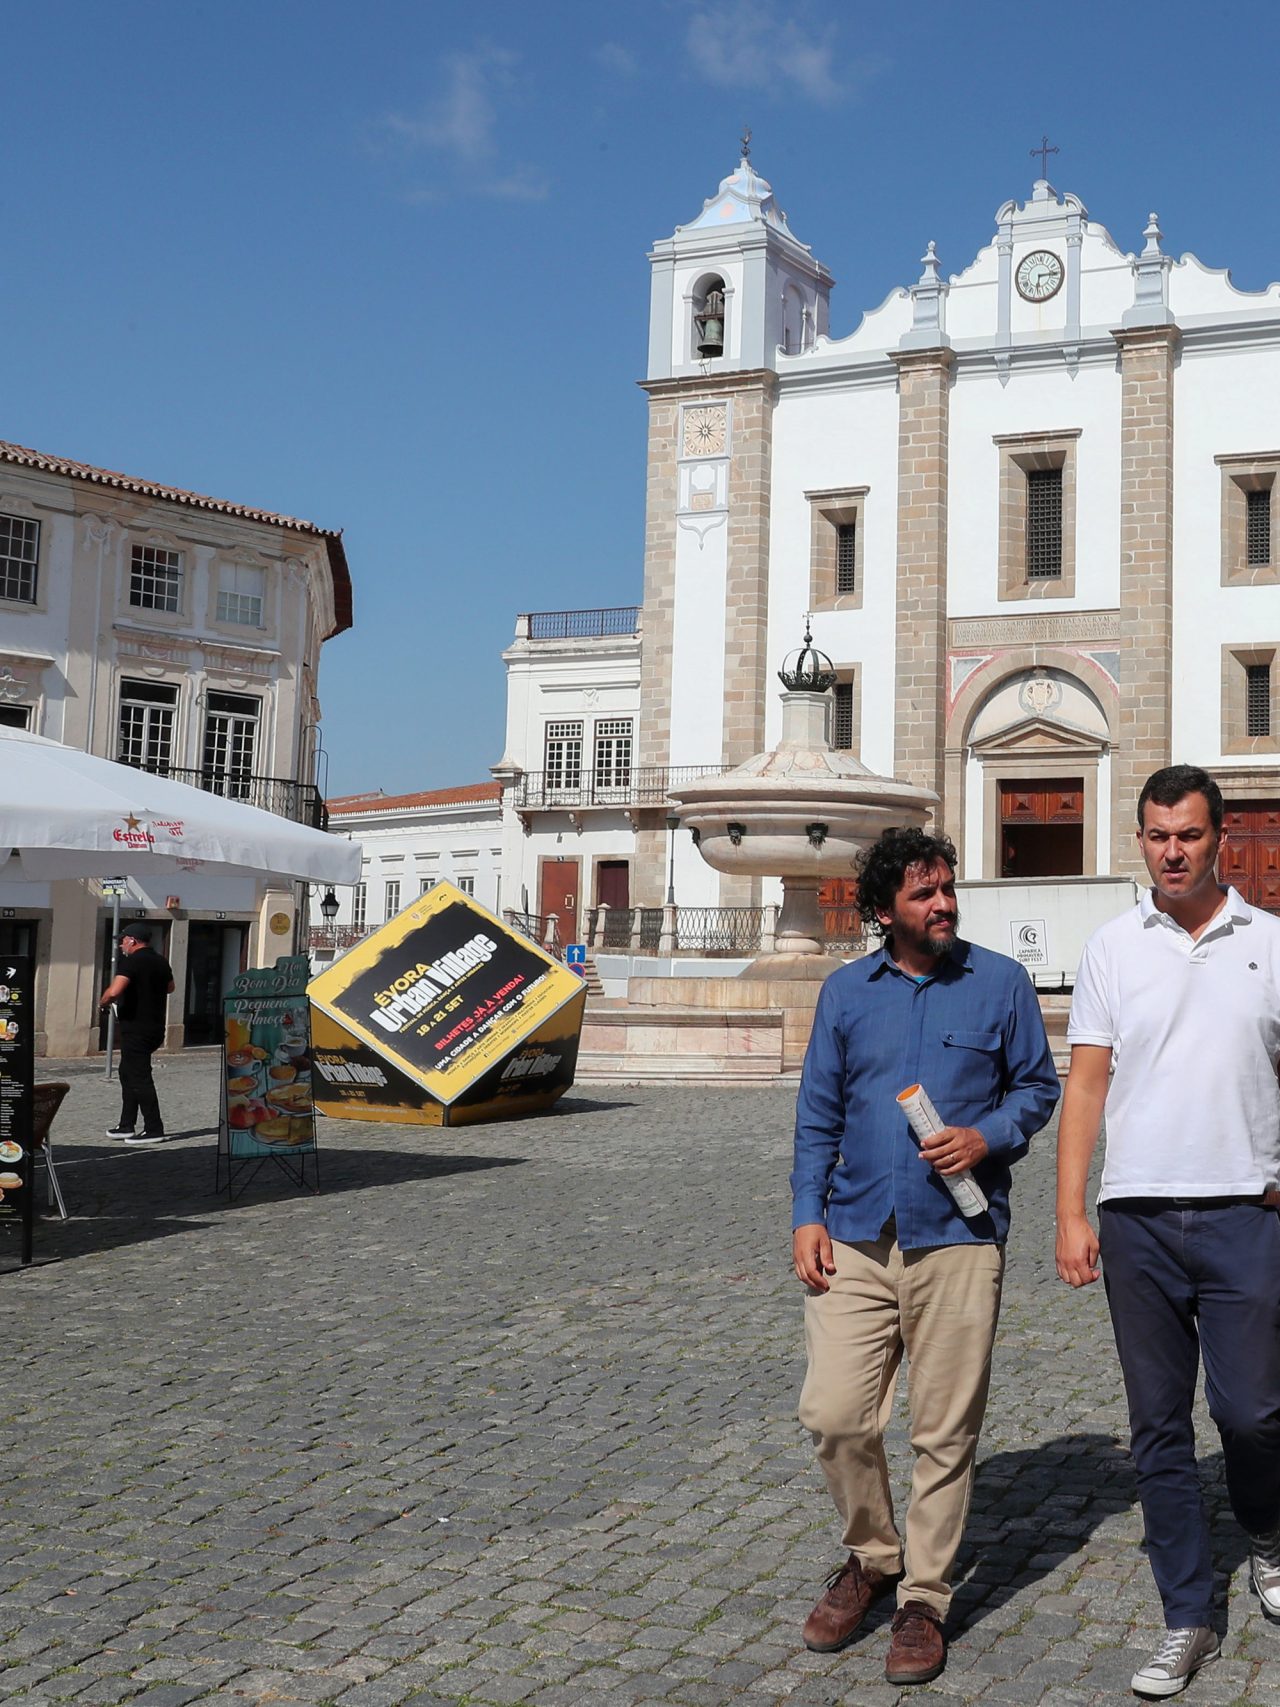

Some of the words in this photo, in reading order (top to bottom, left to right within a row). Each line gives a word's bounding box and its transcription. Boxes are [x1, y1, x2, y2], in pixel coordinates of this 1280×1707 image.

[113, 827, 155, 843] Estrella
[236, 977, 267, 995] Bom
[271, 975, 300, 993] Dia
[369, 977, 443, 1034] Urban
[425, 933, 498, 988] Village
[373, 963, 432, 1007] ÉVORA
[234, 998, 289, 1014] Pequeno
[444, 994, 465, 1013] SET
[432, 1008, 447, 1022] 21
[433, 1015, 475, 1051] BILHETES
[470, 1003, 487, 1019] JÁ
[484, 994, 497, 1007] À
[493, 974, 525, 1000] VENDA!
[415, 1022, 431, 1037] 18
[428, 1019, 437, 1027] A
[433, 1054, 452, 1070] UMA
[449, 1035, 474, 1057] CIDADE
[471, 1030, 479, 1038] A
[477, 1010, 505, 1034] DANÇAR
[501, 997, 517, 1012] COM
[515, 993, 522, 1001] O
[521, 974, 548, 997] FUTURO!
[315, 1051, 347, 1065] ÉVORA
